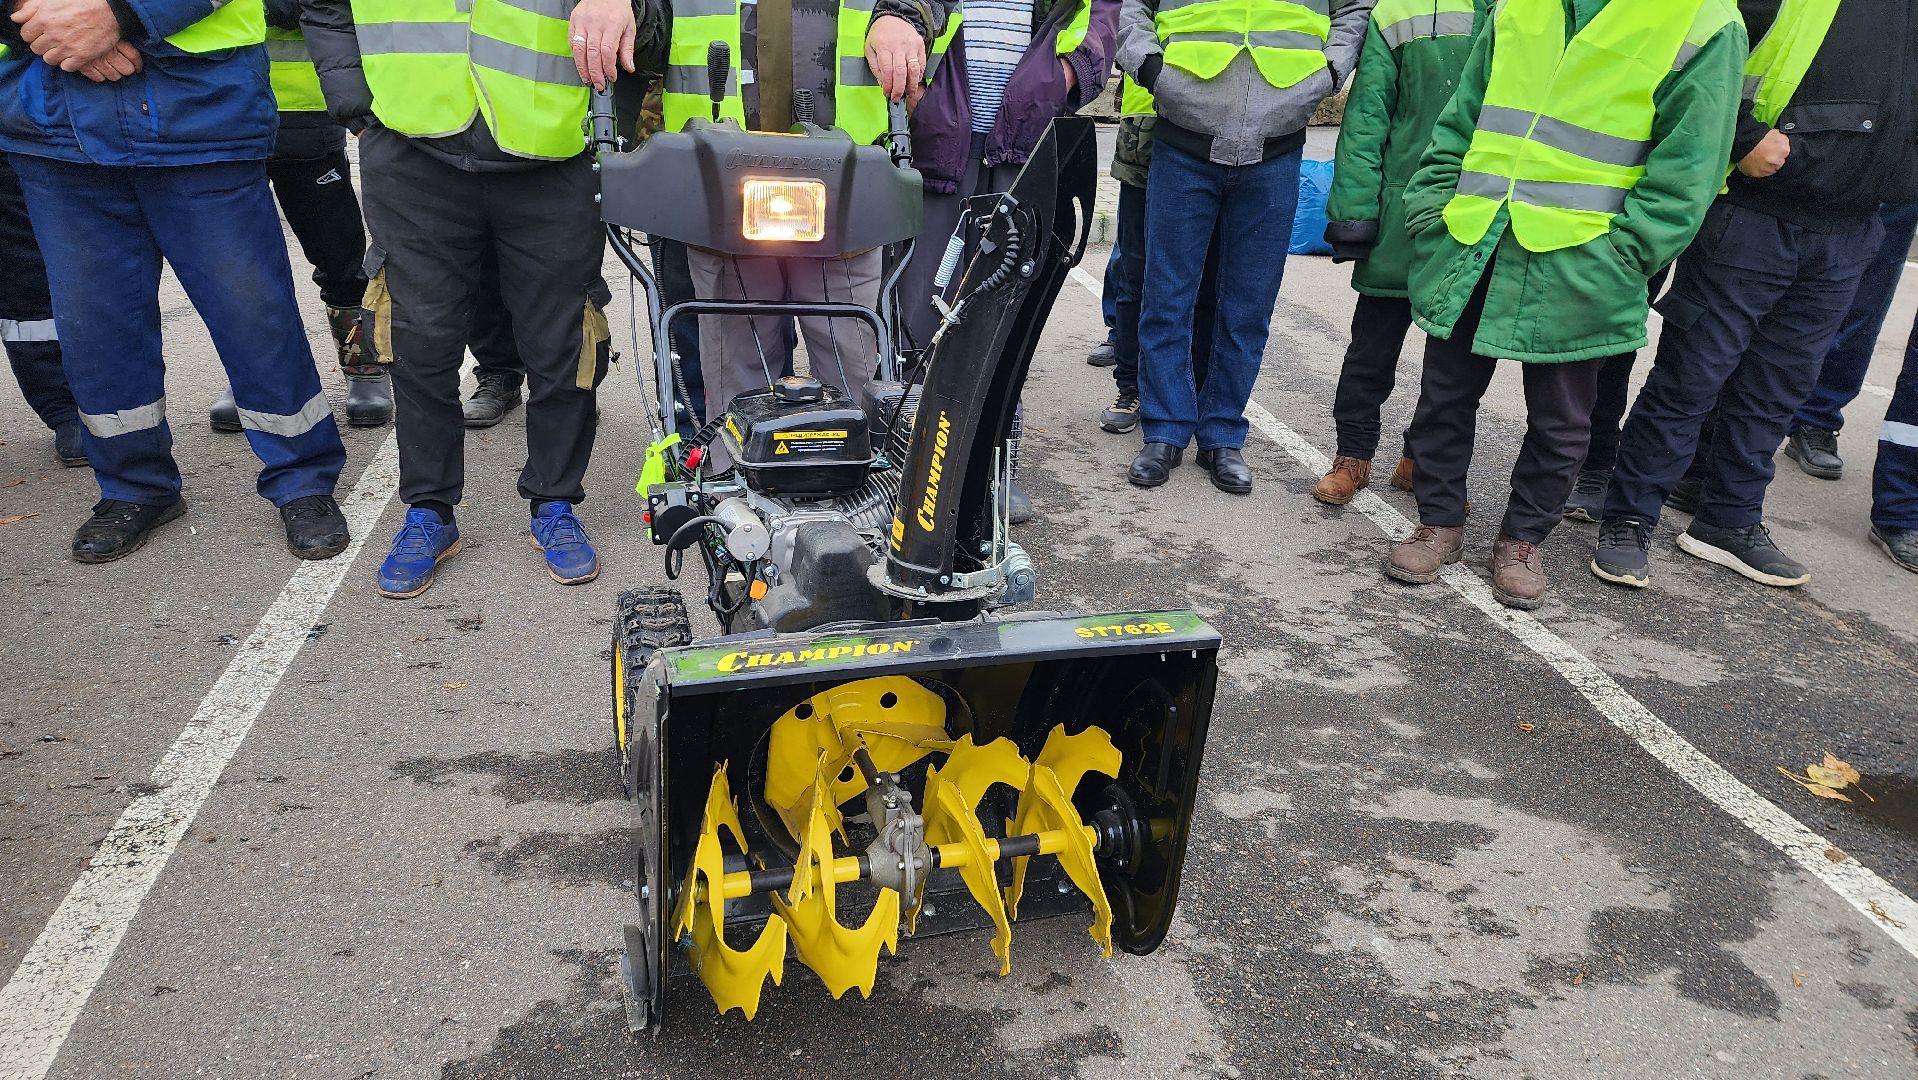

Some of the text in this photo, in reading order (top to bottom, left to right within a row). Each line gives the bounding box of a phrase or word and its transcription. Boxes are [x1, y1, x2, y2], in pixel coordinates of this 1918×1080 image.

[725, 146, 840, 172] CHAMPION
[917, 411, 951, 532] CHAMPION
[1074, 622, 1176, 638] ST762E
[716, 641, 920, 672] CHAMPION
